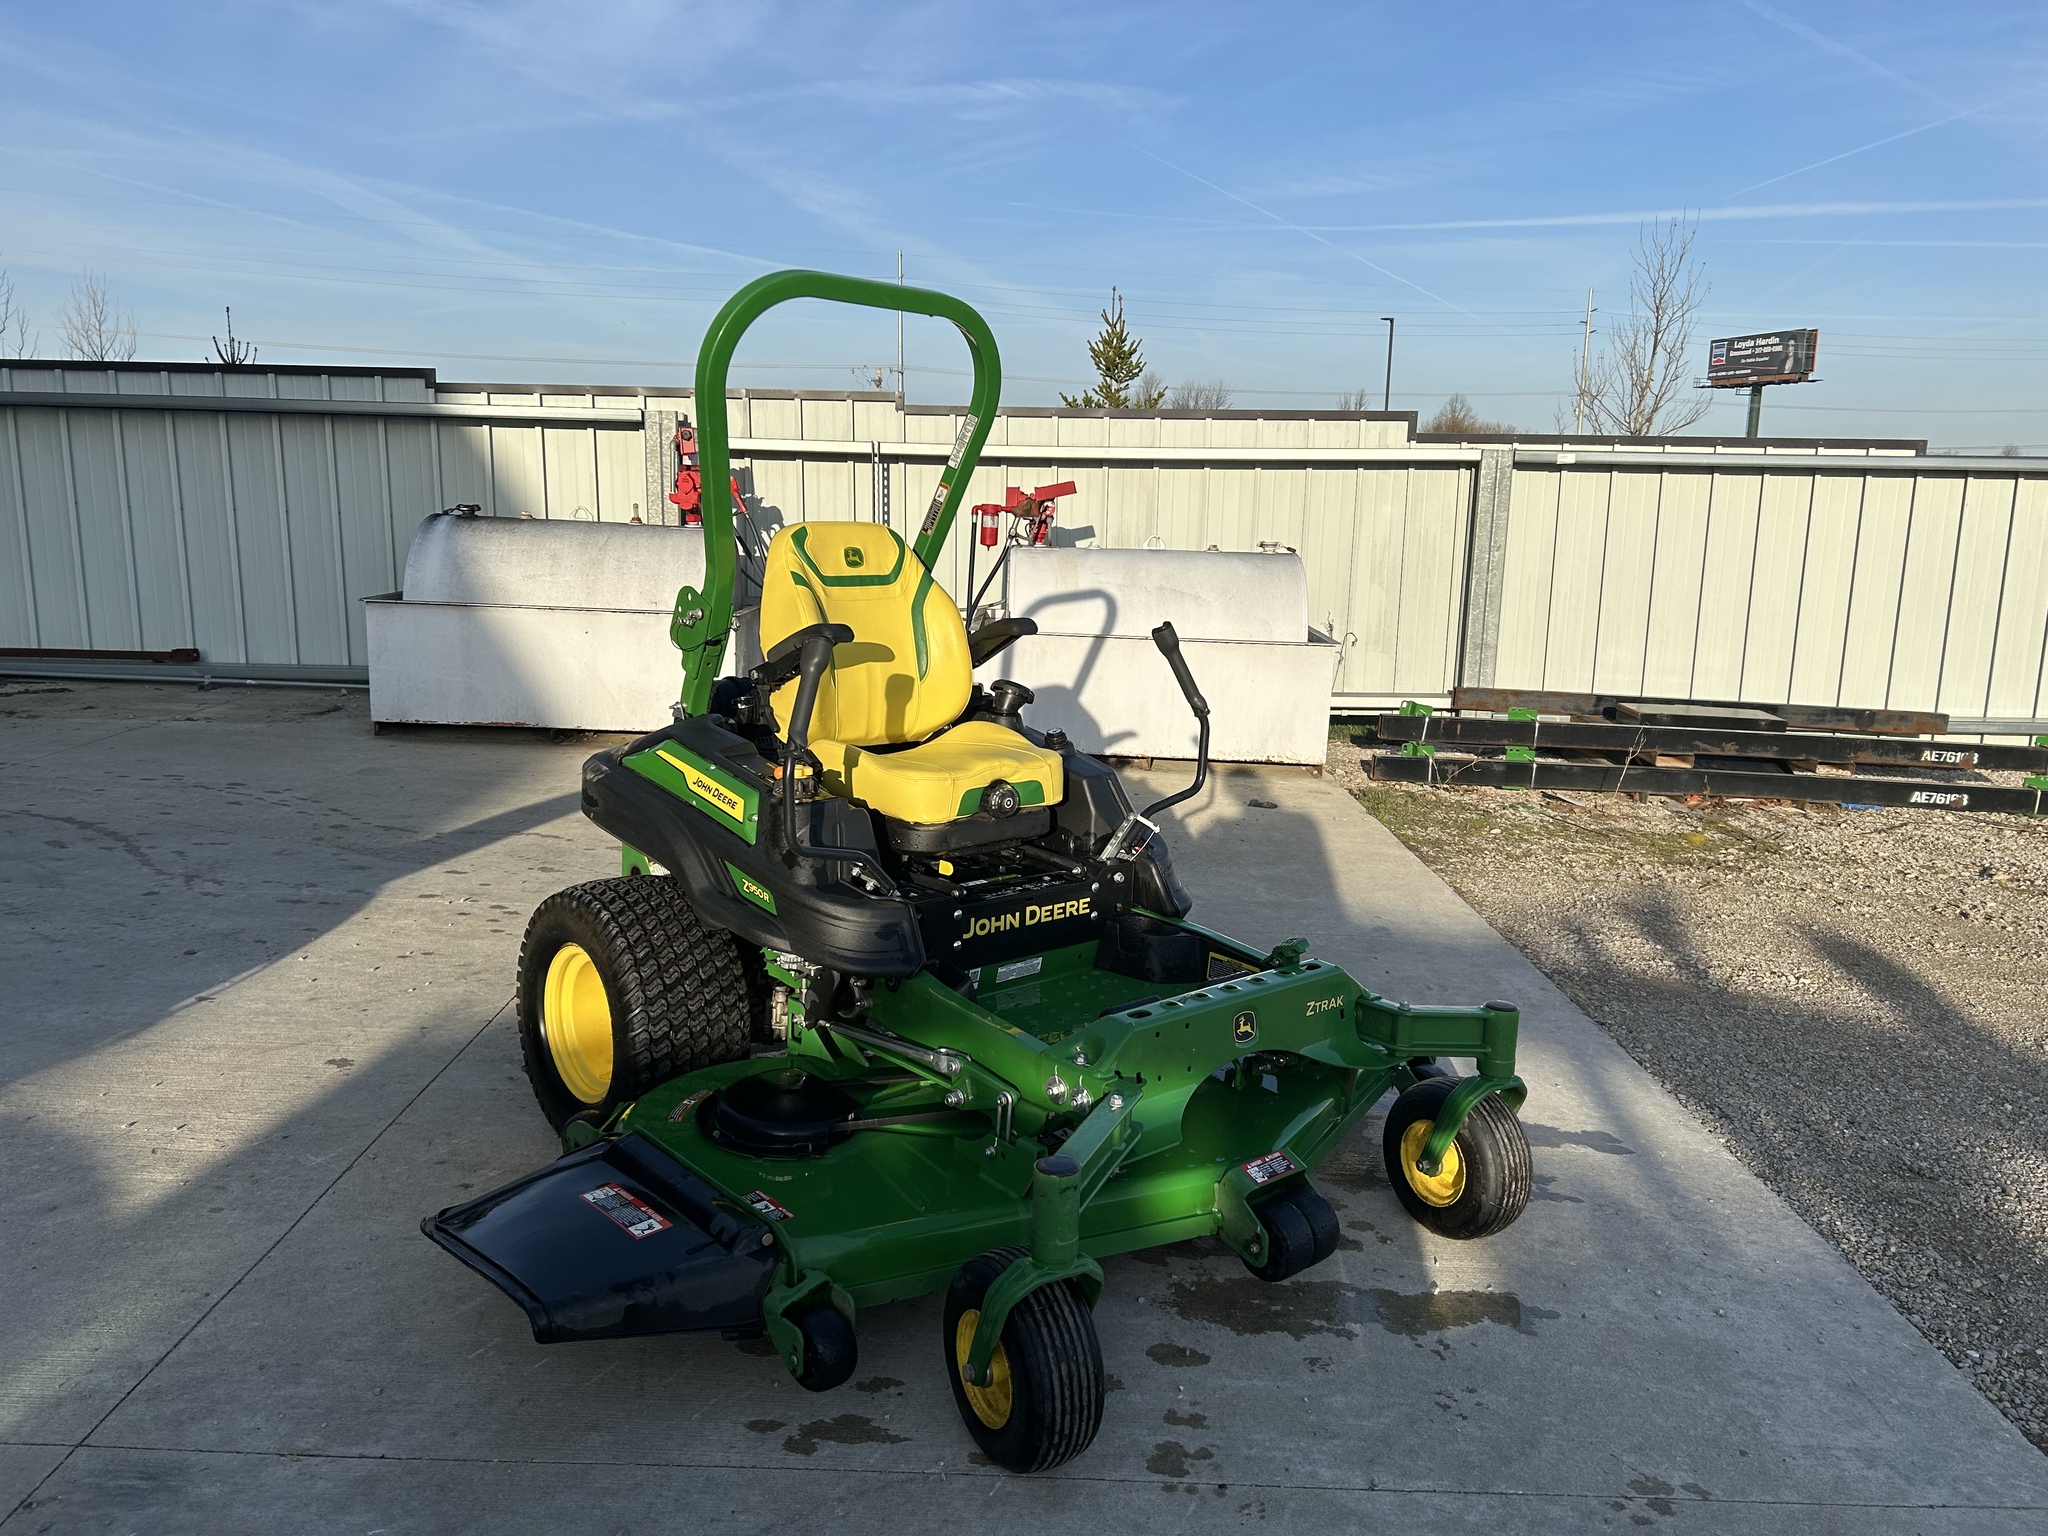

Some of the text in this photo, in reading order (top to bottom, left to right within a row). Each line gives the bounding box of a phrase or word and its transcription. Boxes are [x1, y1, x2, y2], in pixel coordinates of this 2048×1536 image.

[1755, 336, 1779, 346] Hardin
[692, 776, 738, 810] JOHN DEERE
[742, 878, 770, 903] Z950R
[962, 897, 1091, 940] JOHN DEERE
[1306, 995, 1344, 1017] ZTRAK
